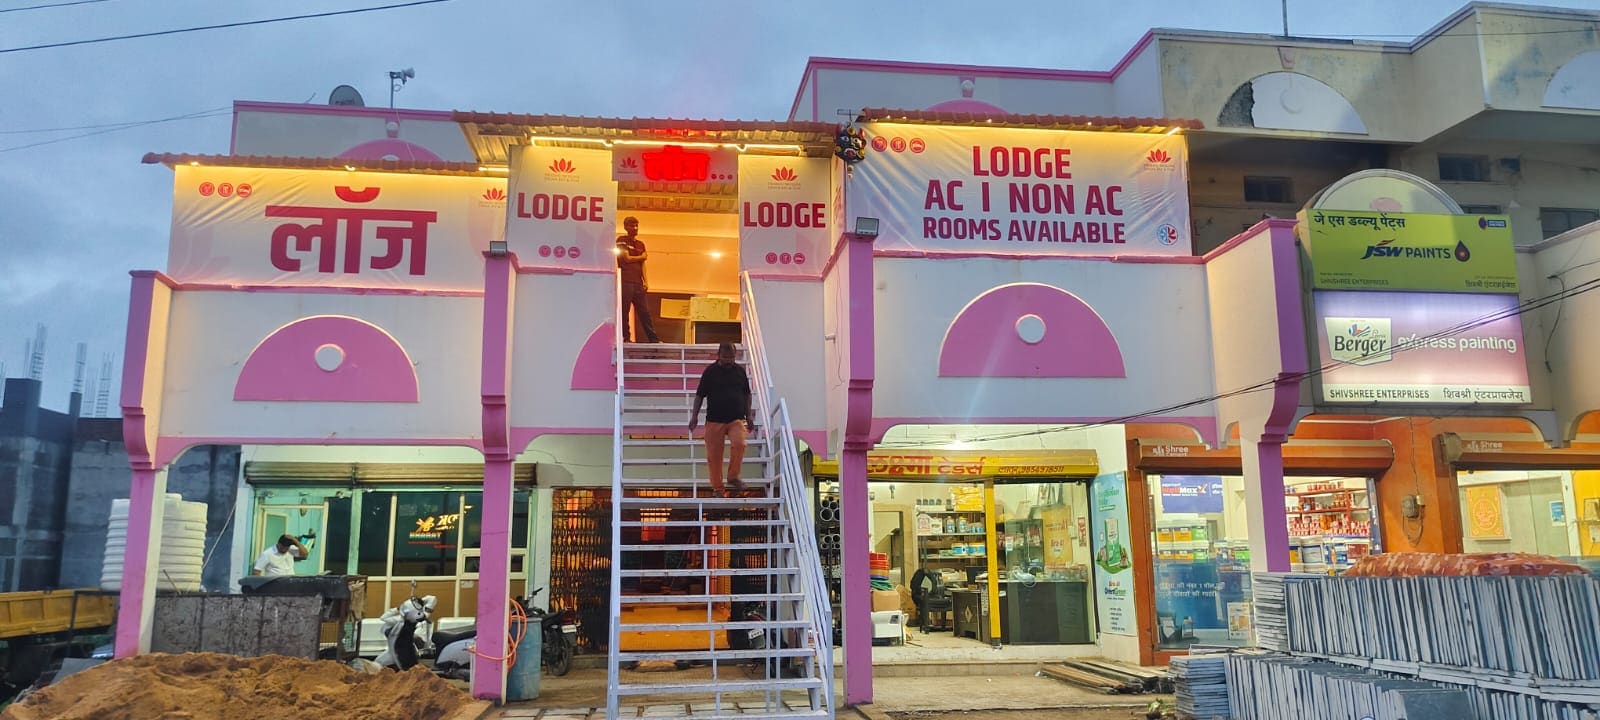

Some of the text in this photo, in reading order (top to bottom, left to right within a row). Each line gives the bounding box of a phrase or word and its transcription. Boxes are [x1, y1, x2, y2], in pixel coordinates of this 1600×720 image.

[973, 145, 1072, 179] LODGE
[517, 192, 604, 223] LODGE
[924, 179, 964, 211] AC
[1009, 182, 1075, 215] NON
[1084, 185, 1123, 216] AC
[743, 201, 826, 229] LODGE
[1313, 211, 1406, 231] जे एस डब्ल्यू पेंट्स
[264, 185, 438, 276] लॉज
[923, 216, 1126, 244] ROOMS AVAILABLE
[1360, 245, 1451, 260] JSW PAINTS
[1334, 335, 1387, 357] Berger
[1397, 333, 1457, 350] express
[1459, 335, 1517, 353] painting
[1329, 389, 1430, 399] SHIVSHREE ENTERPRISES
[1165, 445, 1189, 453] Shree
[1481, 439, 1503, 449] Shree
